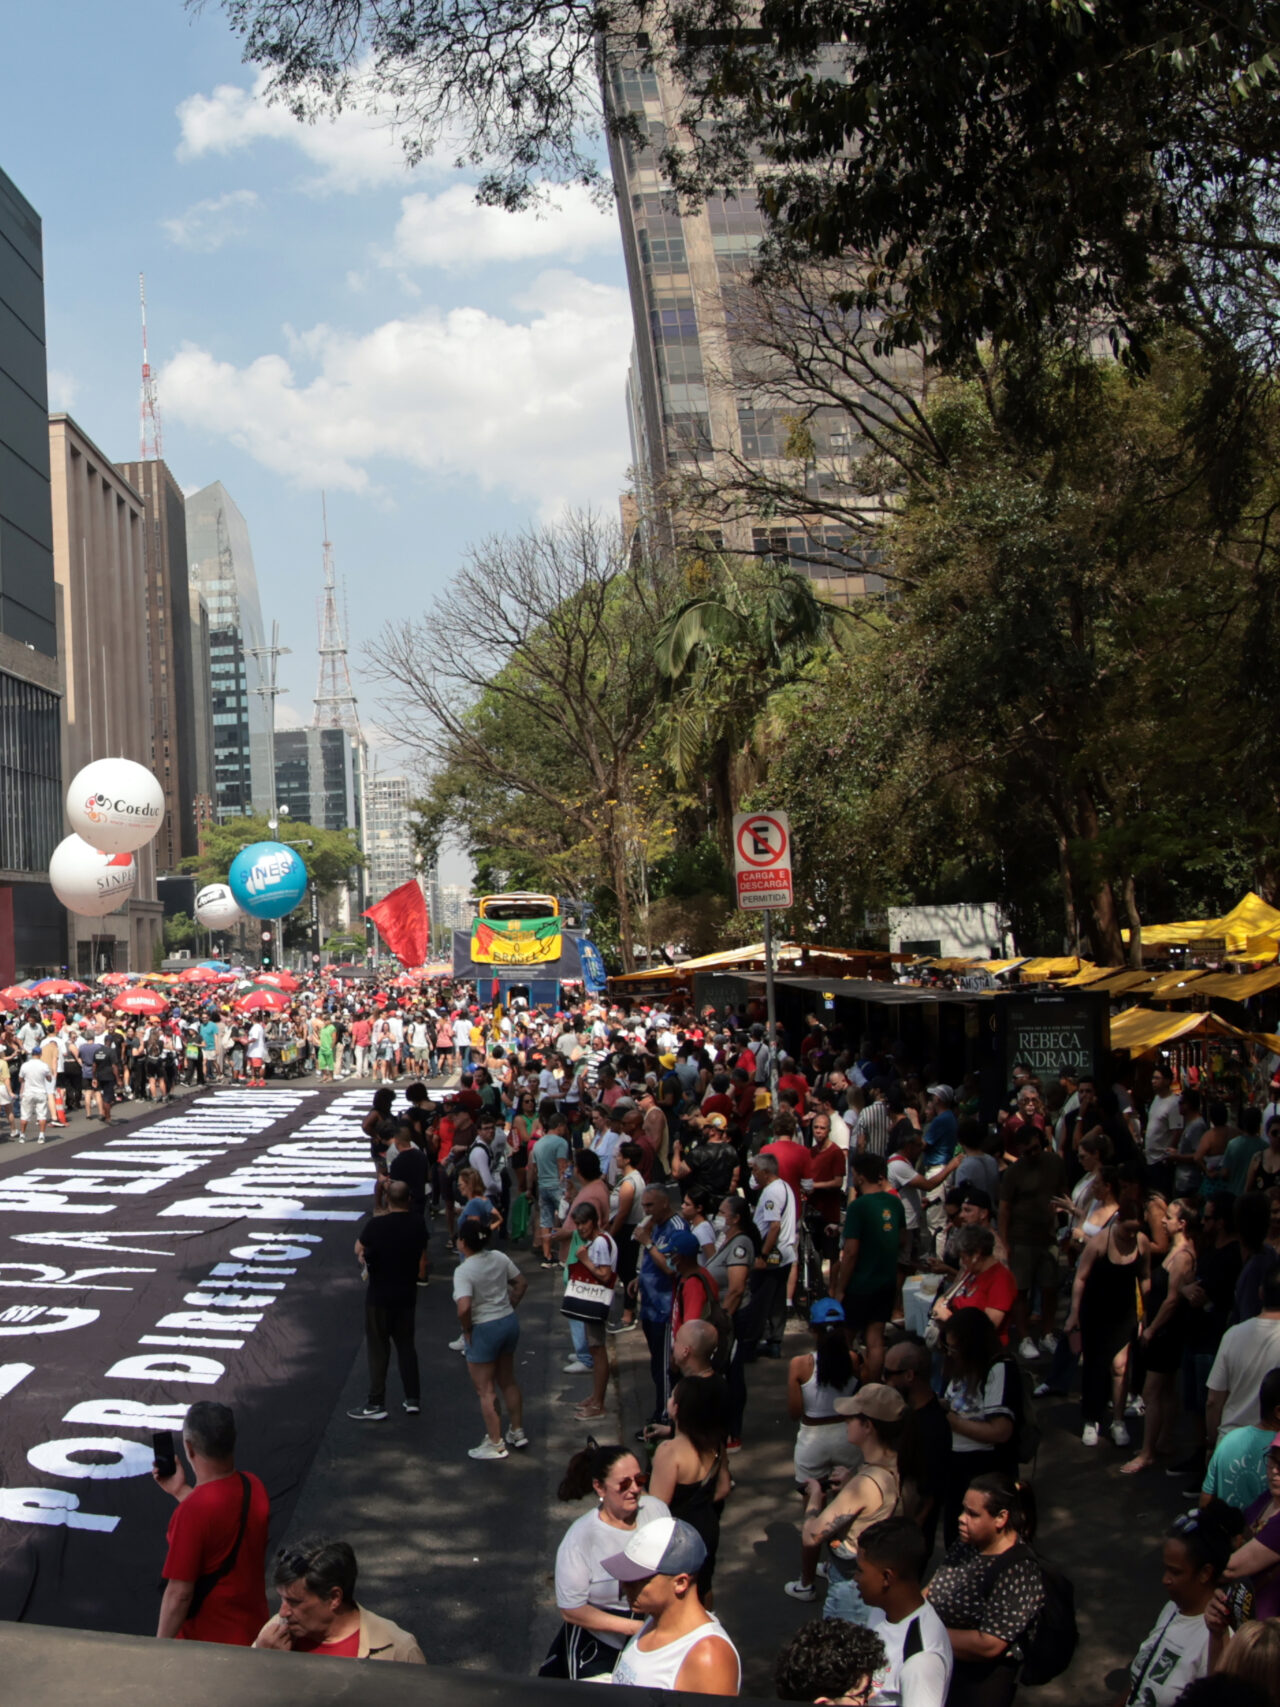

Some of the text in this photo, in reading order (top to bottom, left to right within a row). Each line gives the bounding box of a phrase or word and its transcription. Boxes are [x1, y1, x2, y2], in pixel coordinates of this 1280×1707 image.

[239, 860, 298, 885] SINESP
[742, 870, 785, 881] CARGA E
[740, 879, 788, 890] DESCARGA
[742, 893, 787, 904] PERMITIDA
[1019, 1032, 1081, 1049] REBECA
[1012, 1051, 1089, 1068] ANDRADE
[104, 1107, 296, 1146] VIDA
[570, 1280, 606, 1297] TOMMY
[105, 1232, 323, 1384] DIREITOS
